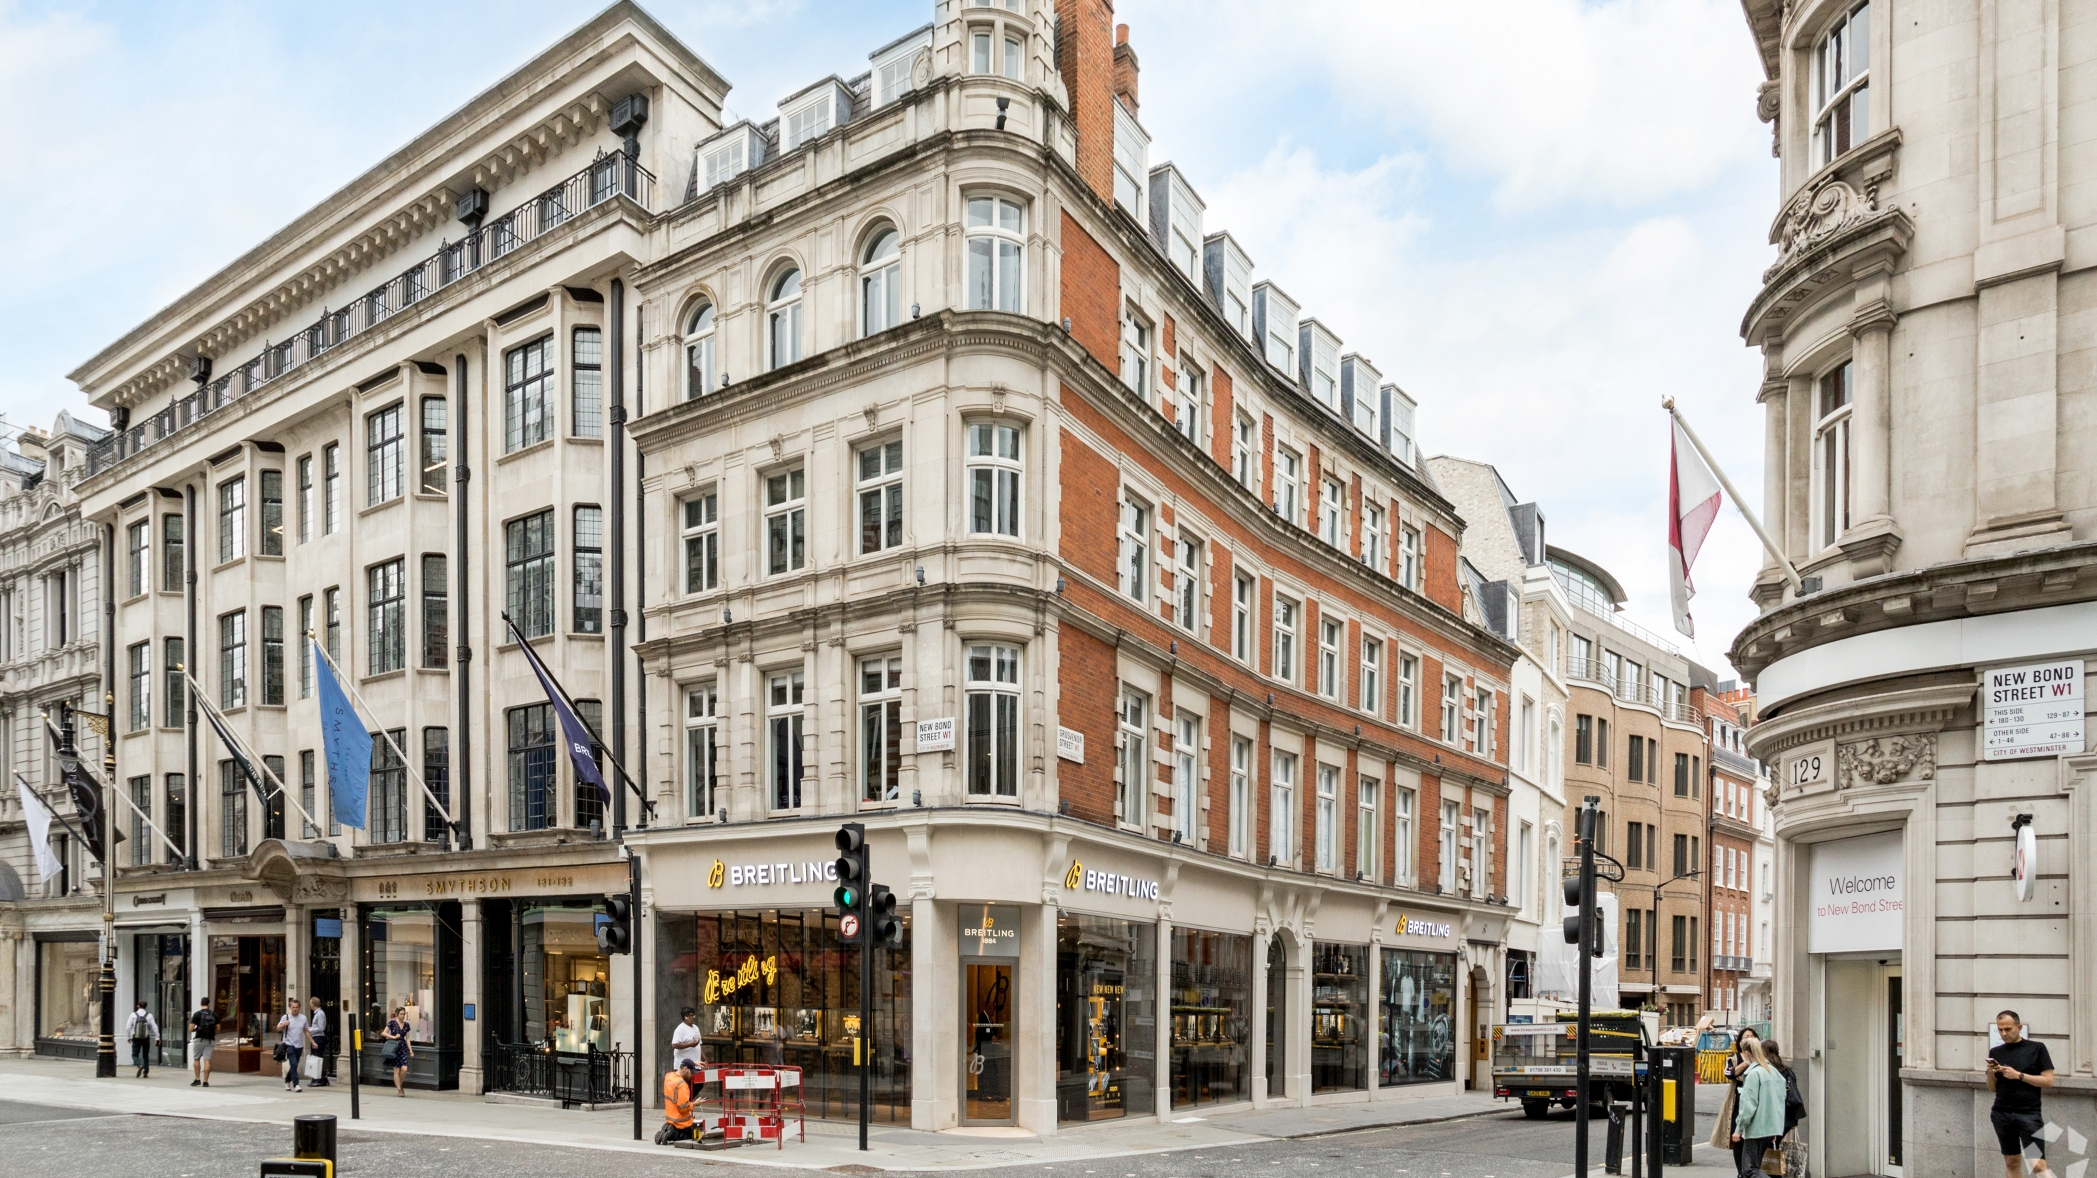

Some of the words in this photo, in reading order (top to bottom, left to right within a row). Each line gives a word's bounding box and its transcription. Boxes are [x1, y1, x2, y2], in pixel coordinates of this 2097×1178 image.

[1993, 671, 2026, 687] NEW
[2033, 666, 2074, 683] BOND
[1993, 685, 2045, 703] STREET
[2051, 682, 2072, 697] W1
[919, 722, 934, 732] NEW
[934, 720, 952, 731] BOND
[919, 731, 941, 742] STREET
[942, 730, 951, 739] W1
[1059, 728, 1083, 744] GROSVENOR
[1059, 738, 1074, 750] STREET
[2019, 744, 2067, 754] WESTMINSTER
[1794, 756, 1821, 785] 129
[731, 861, 838, 885] BREITLING
[426, 877, 511, 895] SMYTHSON
[1085, 869, 1158, 900] BREITLING
[1829, 875, 1896, 895] Welcome
[1817, 906, 1827, 917] to
[1827, 903, 1849, 916] New
[1851, 900, 1876, 914] Bond
[964, 928, 1015, 938] BREITLING
[1407, 920, 1450, 938] BREITLING
